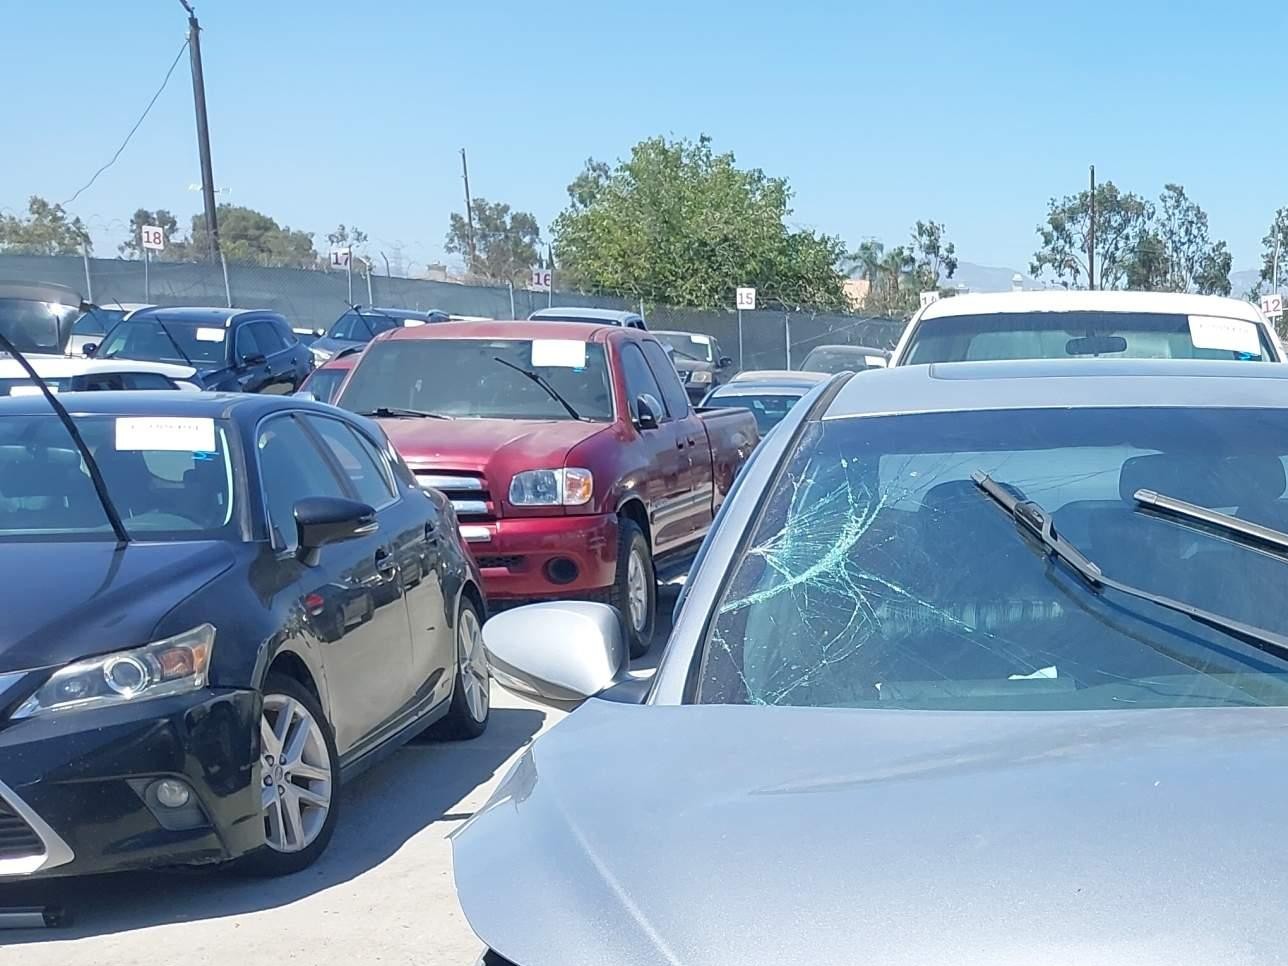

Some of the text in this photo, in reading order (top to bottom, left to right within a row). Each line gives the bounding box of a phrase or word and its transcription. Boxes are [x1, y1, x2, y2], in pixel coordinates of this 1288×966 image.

[143, 230, 162, 246] 18
[332, 252, 350, 266] 17
[534, 272, 551, 287] 16
[738, 292, 753, 305] 15
[1263, 299, 1281, 313] 12
